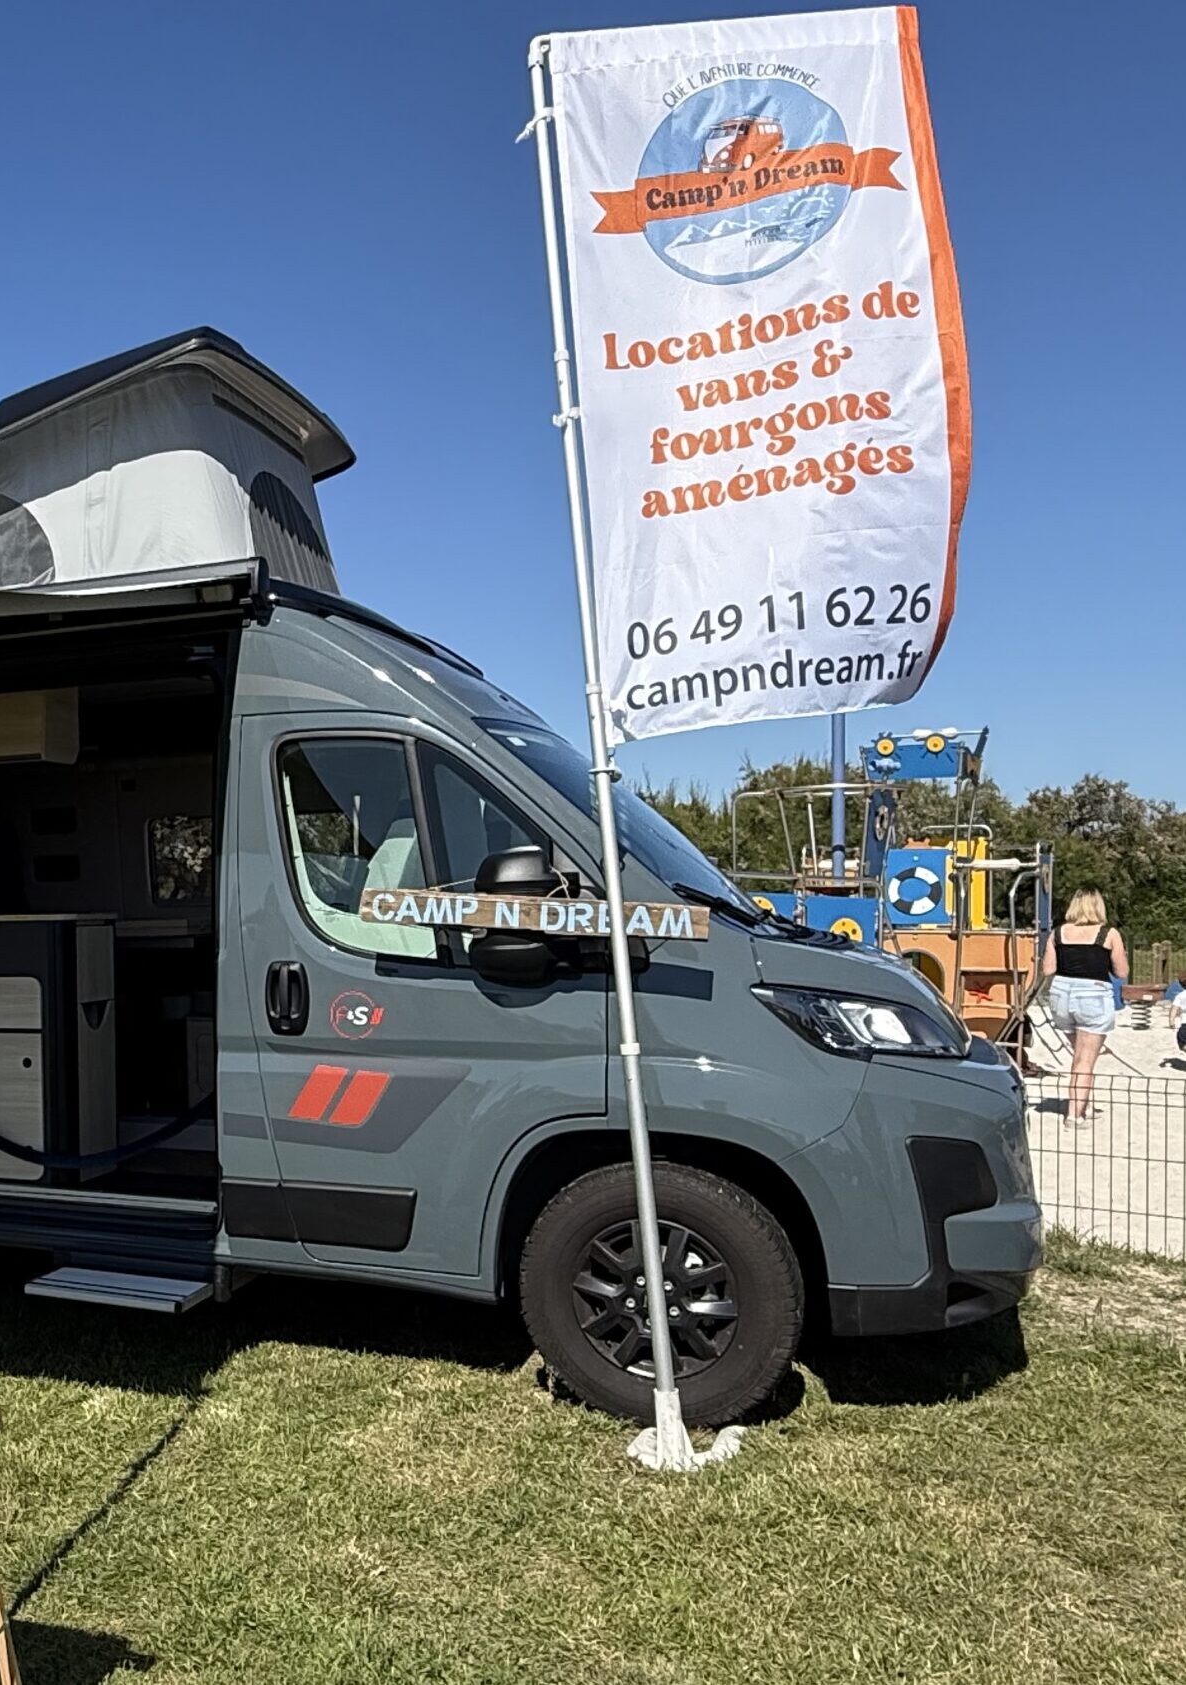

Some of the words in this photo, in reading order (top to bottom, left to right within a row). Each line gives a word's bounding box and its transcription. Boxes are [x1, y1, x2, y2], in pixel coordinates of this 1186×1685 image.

[662, 83, 689, 108] QUE
[757, 63, 821, 89] COMMENCE
[645, 175, 748, 211] Camp'n
[754, 154, 846, 191] Dream
[603, 293, 851, 370] Locations
[861, 281, 921, 320] de
[675, 357, 800, 411] vans
[811, 339, 853, 378] &
[649, 390, 892, 465] fourgons
[641, 437, 915, 519] aménagés
[626, 617, 678, 660] 06
[689, 604, 743, 648] 49
[759, 590, 806, 633] 11
[825, 585, 876, 628] 62
[886, 582, 932, 624] 26
[625, 639, 923, 711] campndream.fr
[372, 893, 478, 924] CAMP
[495, 900, 520, 928] N
